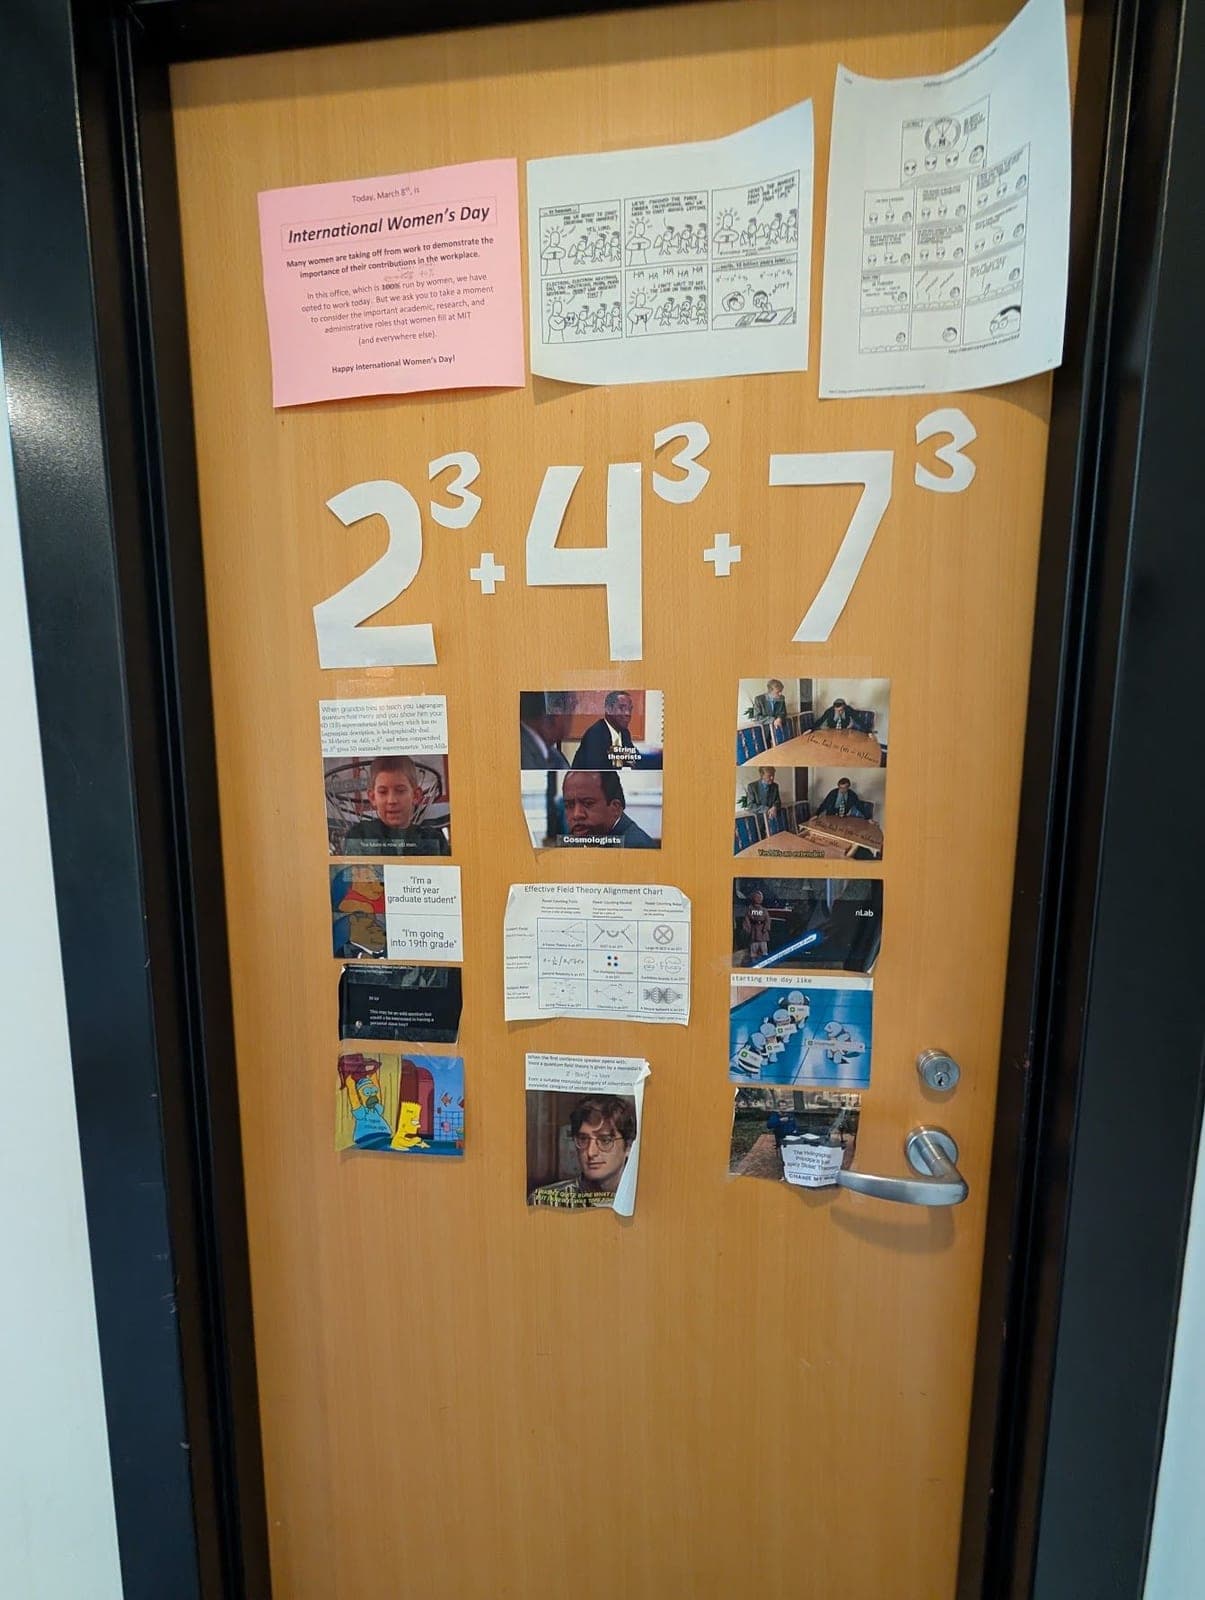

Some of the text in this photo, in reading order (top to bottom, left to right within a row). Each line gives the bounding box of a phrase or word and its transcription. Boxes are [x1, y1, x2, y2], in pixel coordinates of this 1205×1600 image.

[352, 194, 376, 203] Today,
[377, 190, 400, 199] March
[289, 218, 383, 243] International
[460, 207, 490, 221] Day
[308, 256, 334, 265] women
[349, 250, 370, 259] taking
[372, 249, 382, 257] off
[403, 245, 421, 253] work
[433, 238, 479, 249] demonstrate
[481, 236, 494, 244] the
[300, 268, 340, 279] importance
[350, 264, 366, 272] their
[368, 258, 416, 270] contributions
[440, 251, 480, 260] workplace.
[663, 265, 674, 275] HA
[330, 289, 351, 298] office,
[352, 285, 372, 294] which
[426, 278, 455, 286] women,
[301, 304, 322, 312] opted
[333, 301, 349, 309] work
[390, 294, 400, 302] we
[463, 286, 494, 294] moment
[320, 313, 348, 322] consider
[364, 307, 398, 317] important
[400, 304, 435, 313] academic,
[437, 299, 469, 309] research,
[471, 298, 485, 306] and
[325, 323, 373, 333] administrative
[375, 320, 392, 329] roles
[394, 318, 408, 326] that
[409, 316, 436, 325] women
[457, 311, 471, 319] MIT
[359, 337, 374, 346] (and
[376, 333, 416, 342] everywhere
[332, 365, 353, 373] Happy
[356, 358, 400, 370] International
[439, 354, 455, 364] Day!
[470, 553, 505, 594] +
[704, 533, 741, 576] +
[613, 746, 636, 755] String
[563, 836, 621, 845] Cosmologists
[403, 886, 439, 895] third year
[576, 887, 601, 895] Theory
[603, 887, 641, 895] Alignment
[387, 896, 422, 904] graduate
[855, 909, 874, 917] nLab
[420, 931, 444, 940] going
[391, 939, 407, 947] into
[408, 939, 428, 947] 19th
[781, 976, 792, 984] day
